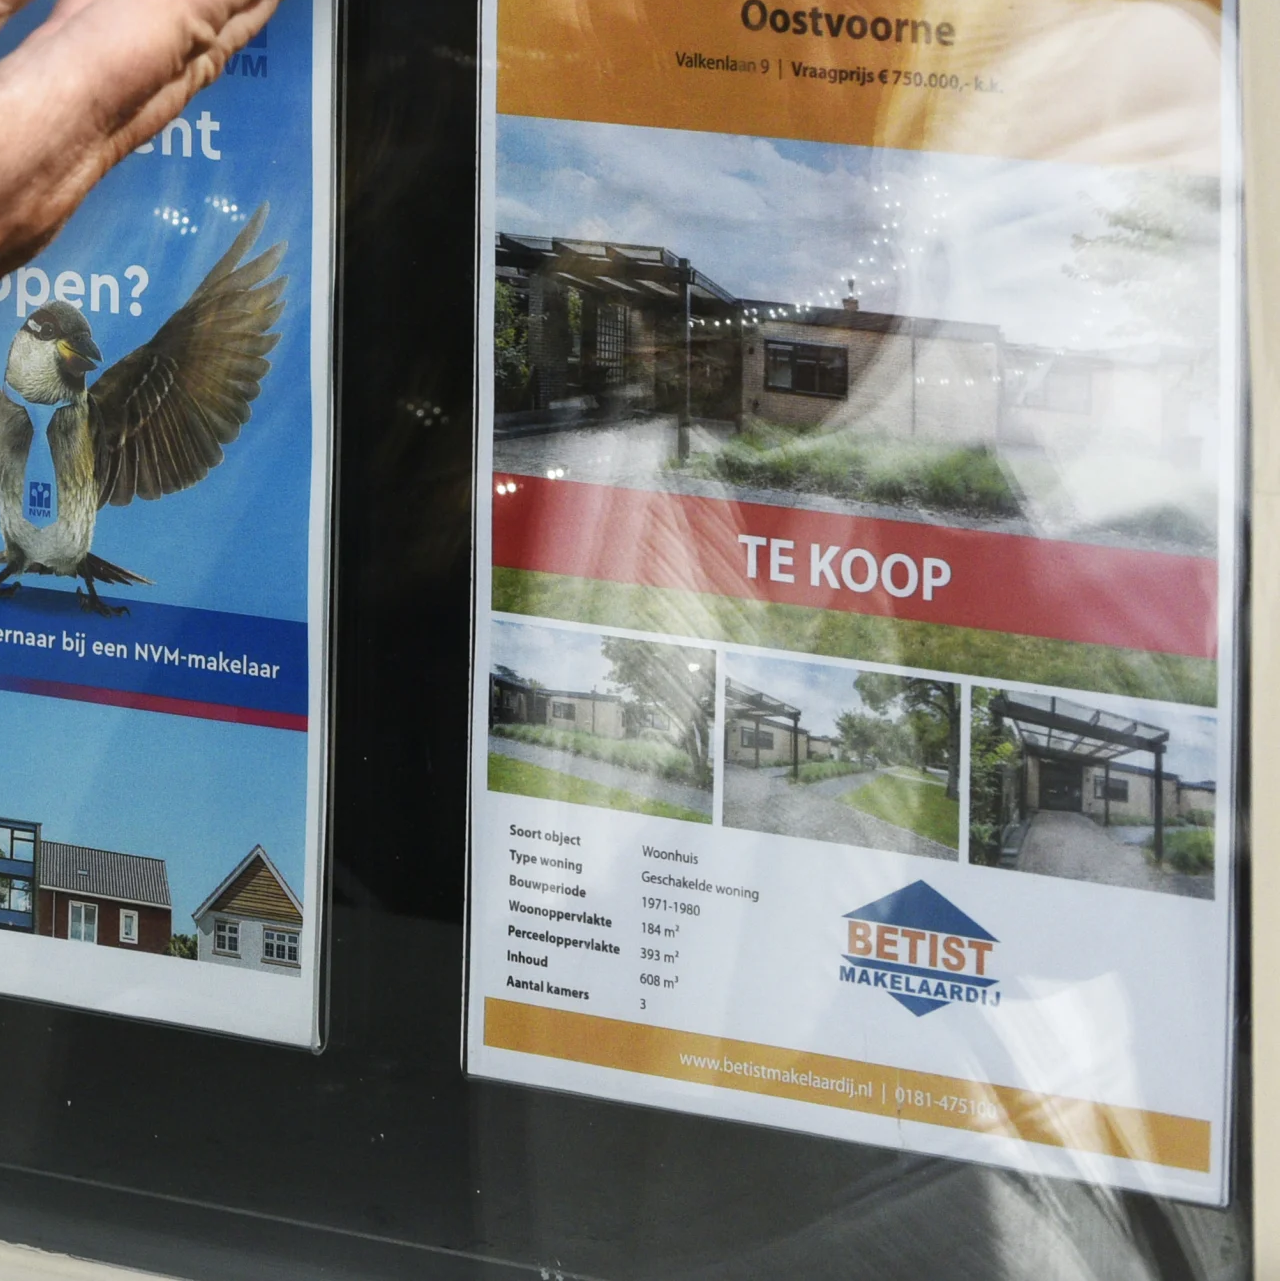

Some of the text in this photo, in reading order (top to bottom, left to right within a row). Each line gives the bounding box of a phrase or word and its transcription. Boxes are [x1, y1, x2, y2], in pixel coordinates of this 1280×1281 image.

[741, 0, 956, 47] Oostvoorne
[225, 54, 267, 78] VM
[675, 52, 756, 73] Valkenlaan
[760, 59, 769, 74] 9
[792, 62, 874, 86] Vraagprijs
[29, 508, 50, 518] NVM
[738, 534, 951, 601] TE KOOP
[62, 631, 86, 657] bij
[92, 641, 127, 659] een
[135, 643, 280, 679] NVM-makelaar
[510, 825, 581, 846] Soort object
[510, 850, 583, 874] Type woning
[642, 845, 698, 865] Woonhuis
[509, 875, 586, 898] Bouwperiode
[641, 871, 759, 902] Geschakelde woning
[509, 900, 612, 927] Woonoppervlakte
[642, 897, 700, 916] 1971-1980
[508, 925, 620, 955] Perceeloppervlakte
[641, 922, 661, 936] 184
[507, 950, 548, 967] Inhoud
[640, 948, 660, 961] 393
[848, 920, 993, 976] BETIST
[507, 976, 589, 1000] Aantal kamers
[640, 973, 660, 986] 608
[840, 965, 1001, 1007] MAKELAARDIJ
[640, 999, 646, 1010] 3
[680, 1051, 996, 1119] www.betistmakelaardij.nl 0181-475100
